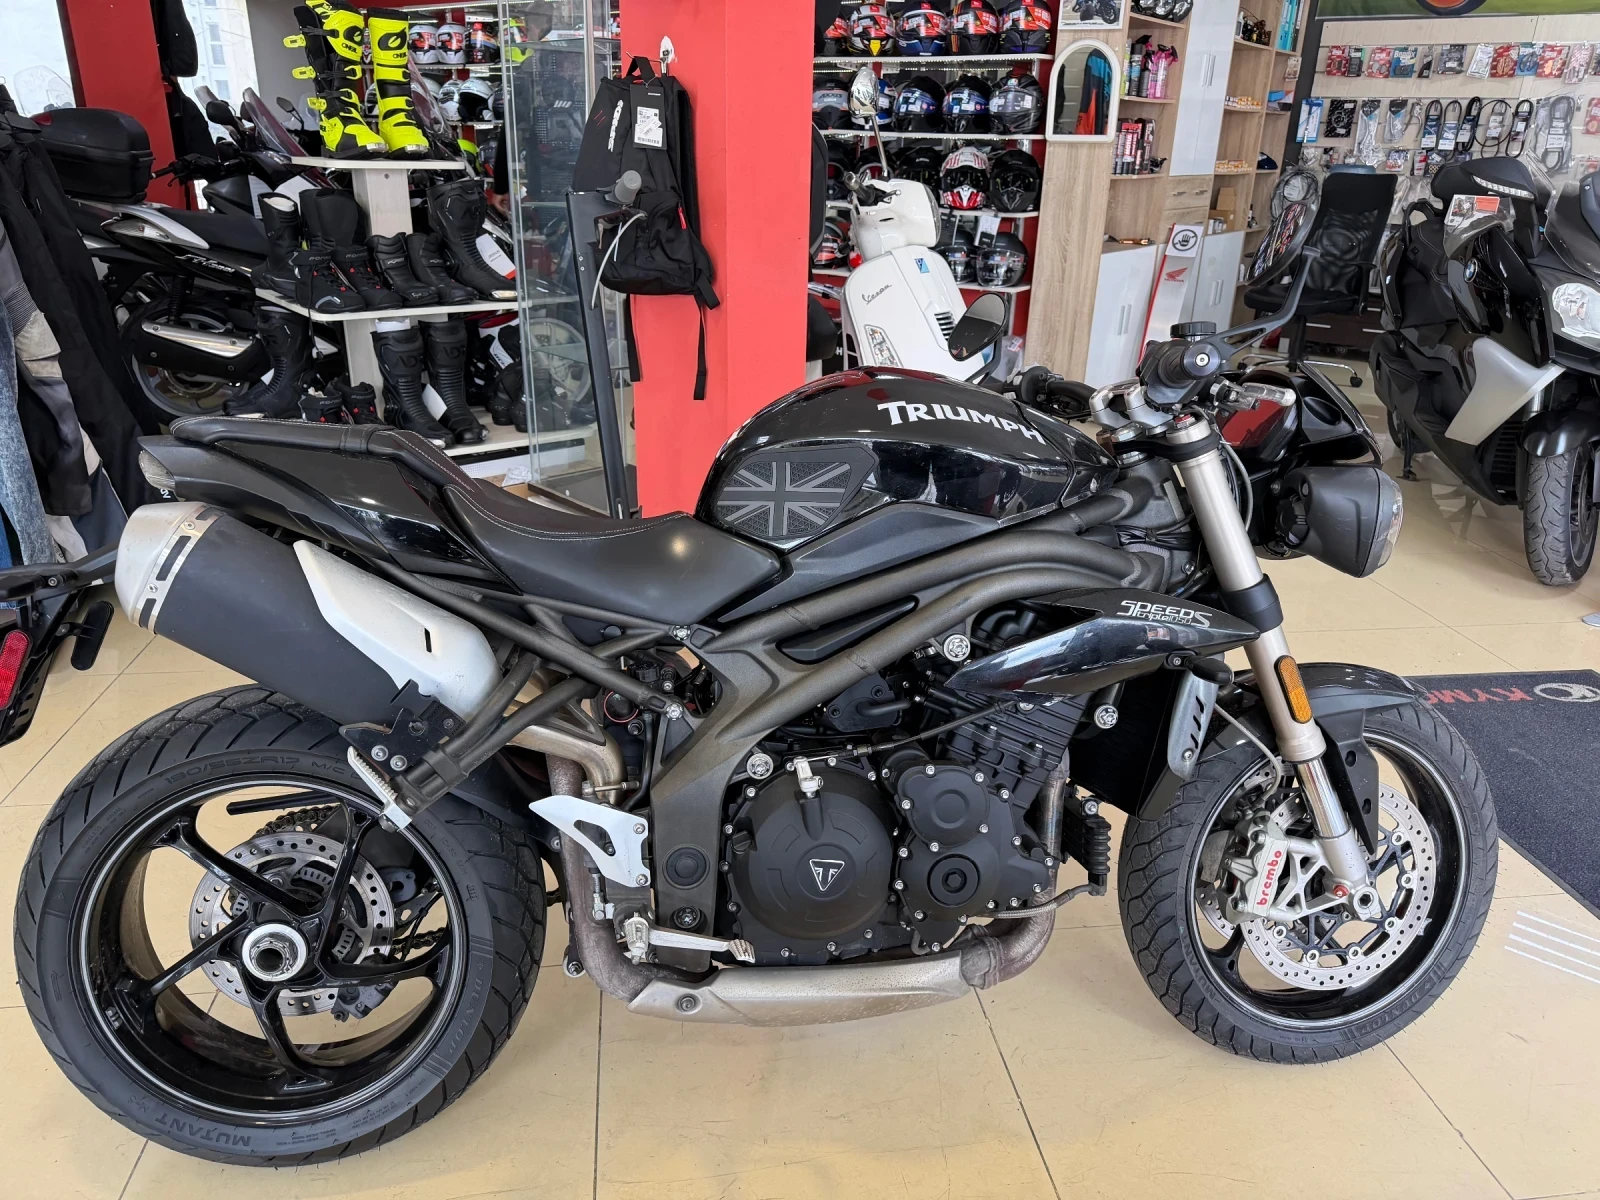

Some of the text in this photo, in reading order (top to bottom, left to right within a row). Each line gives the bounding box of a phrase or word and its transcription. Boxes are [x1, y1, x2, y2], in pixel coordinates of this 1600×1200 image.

[1393, 50, 1416, 58] Bendix
[862, 284, 892, 305] Vespa
[877, 400, 1047, 446] TRIUMPH
[163, 756, 346, 785] 190/55ZR17 M/C
[1256, 850, 1283, 906] brembo
[449, 977, 483, 1054] DUNLOP
[1361, 992, 1419, 1034] DUNLOP
[154, 1111, 252, 1147] MUTANT
